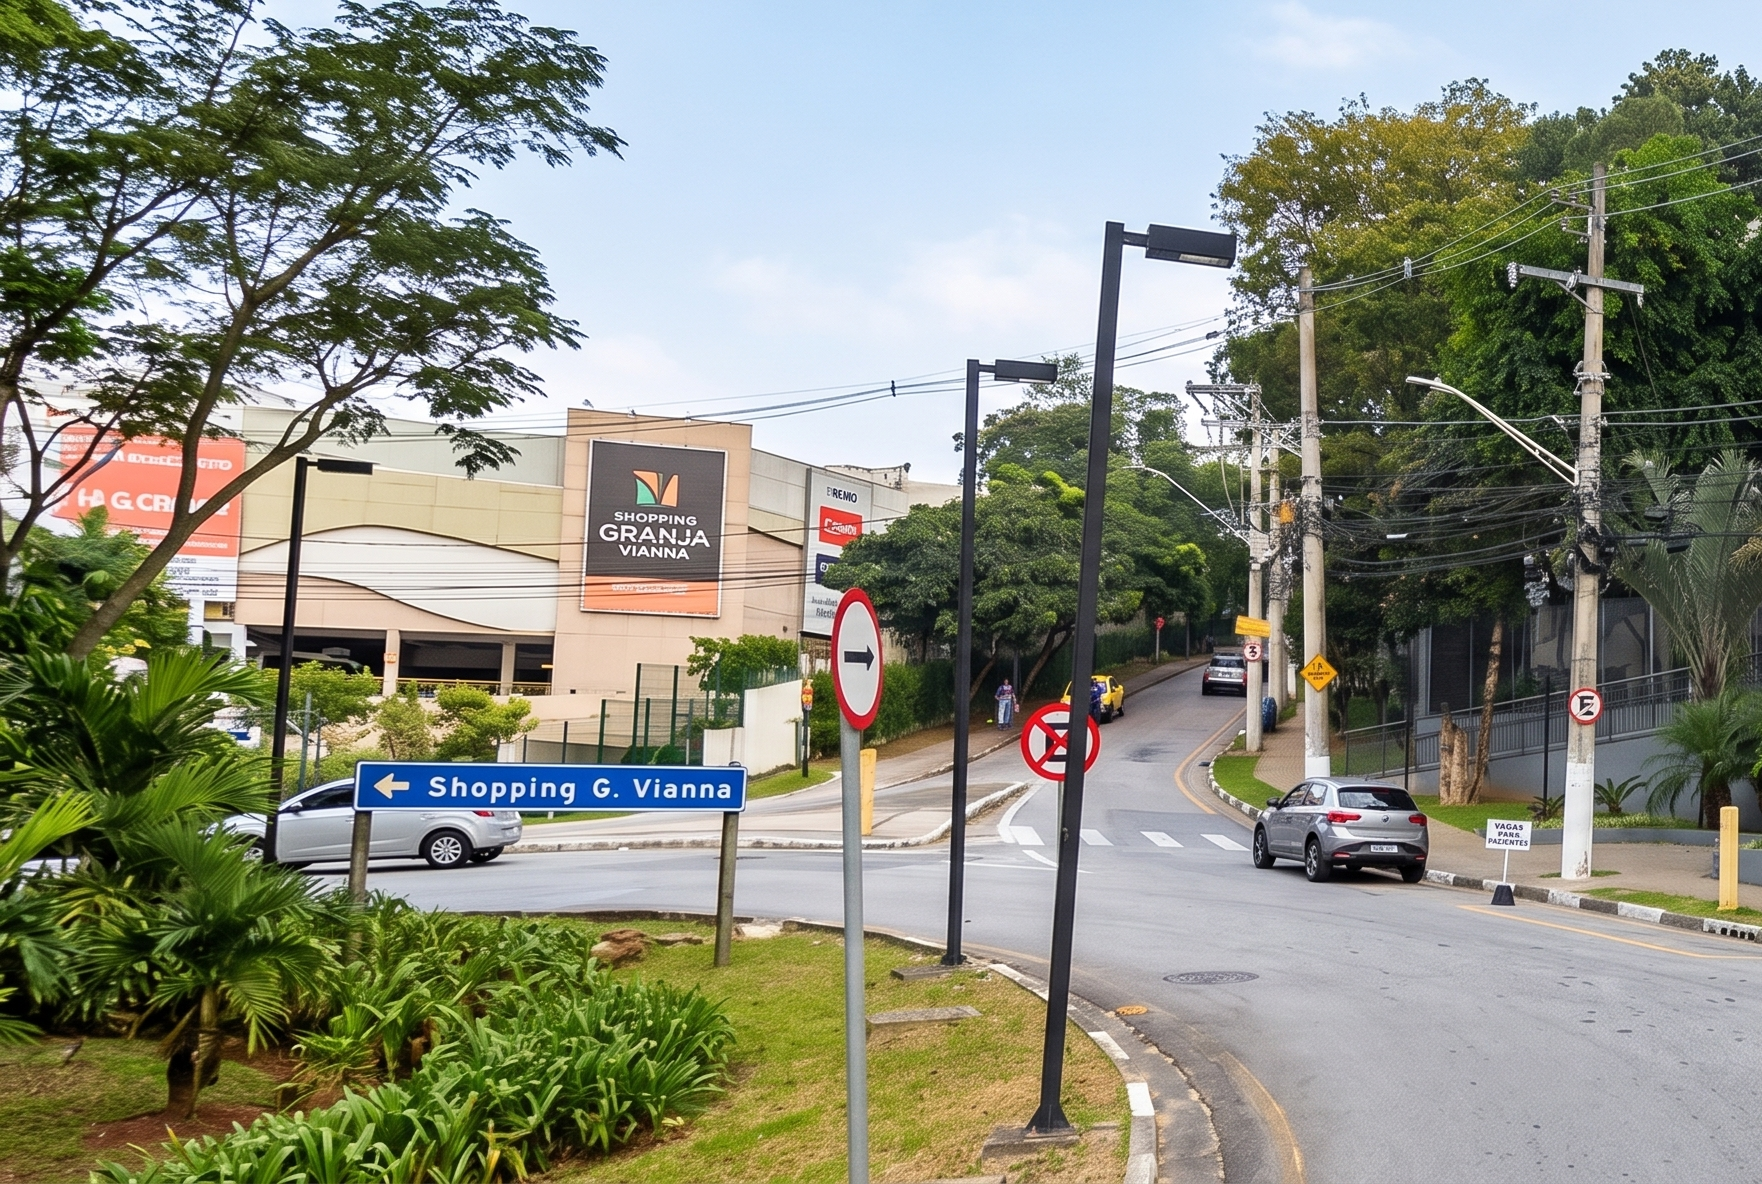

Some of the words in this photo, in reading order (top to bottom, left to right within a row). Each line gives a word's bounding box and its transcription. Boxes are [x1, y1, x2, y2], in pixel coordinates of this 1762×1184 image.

[614, 511, 697, 526] SHOPPING
[599, 523, 711, 548] GRANJA
[618, 544, 690, 560] VIANNA
[428, 776, 576, 804] Shopping
[592, 778, 619, 799] G.
[633, 778, 732, 799] Vianna
[1494, 822, 1524, 831] VAGAS
